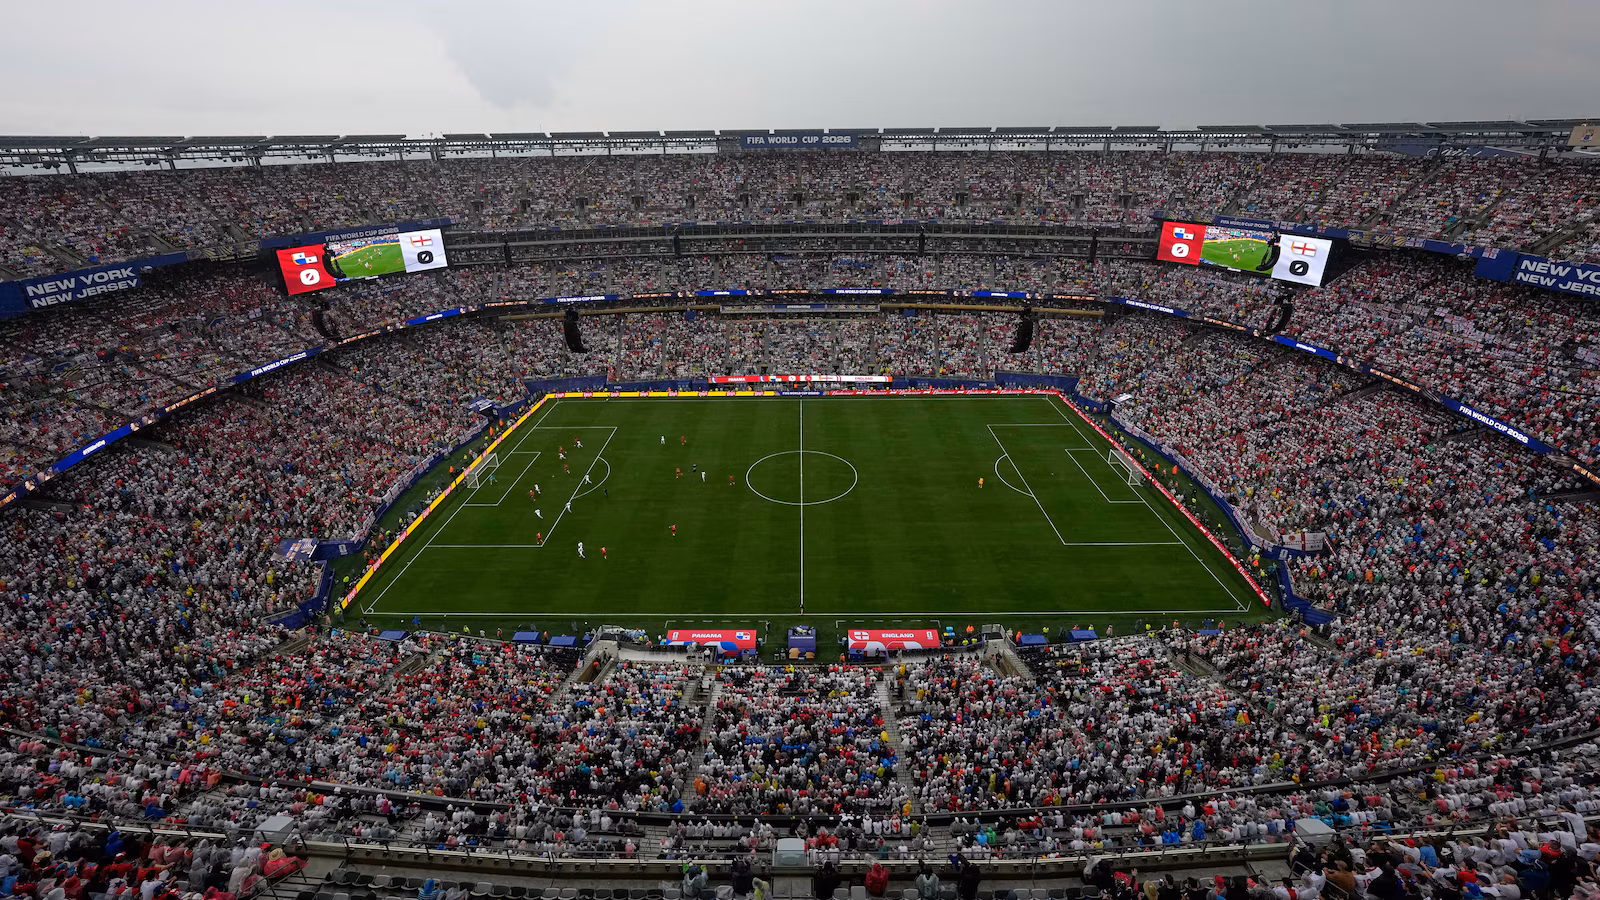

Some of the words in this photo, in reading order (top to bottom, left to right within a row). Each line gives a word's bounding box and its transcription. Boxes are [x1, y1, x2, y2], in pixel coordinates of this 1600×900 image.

[747, 136, 765, 144] FIFA
[822, 136, 851, 144] 2026
[342, 232, 364, 240] WORLD
[365, 230, 377, 238] CUP
[1521, 260, 1571, 277] NEW
[26, 278, 75, 296] NEW
[79, 266, 136, 285] YORK
[1516, 272, 1556, 286] NEW
[31, 292, 72, 308] NEW
[76, 278, 138, 298] JERSEY
[251, 368, 263, 376] FIFA
[262, 361, 280, 372] WORLD
[1459, 406, 1472, 416] FIFA
[1472, 411, 1494, 426] WORLD
[1494, 422, 1508, 432] CUP
[1506, 428, 1529, 444] 2026
